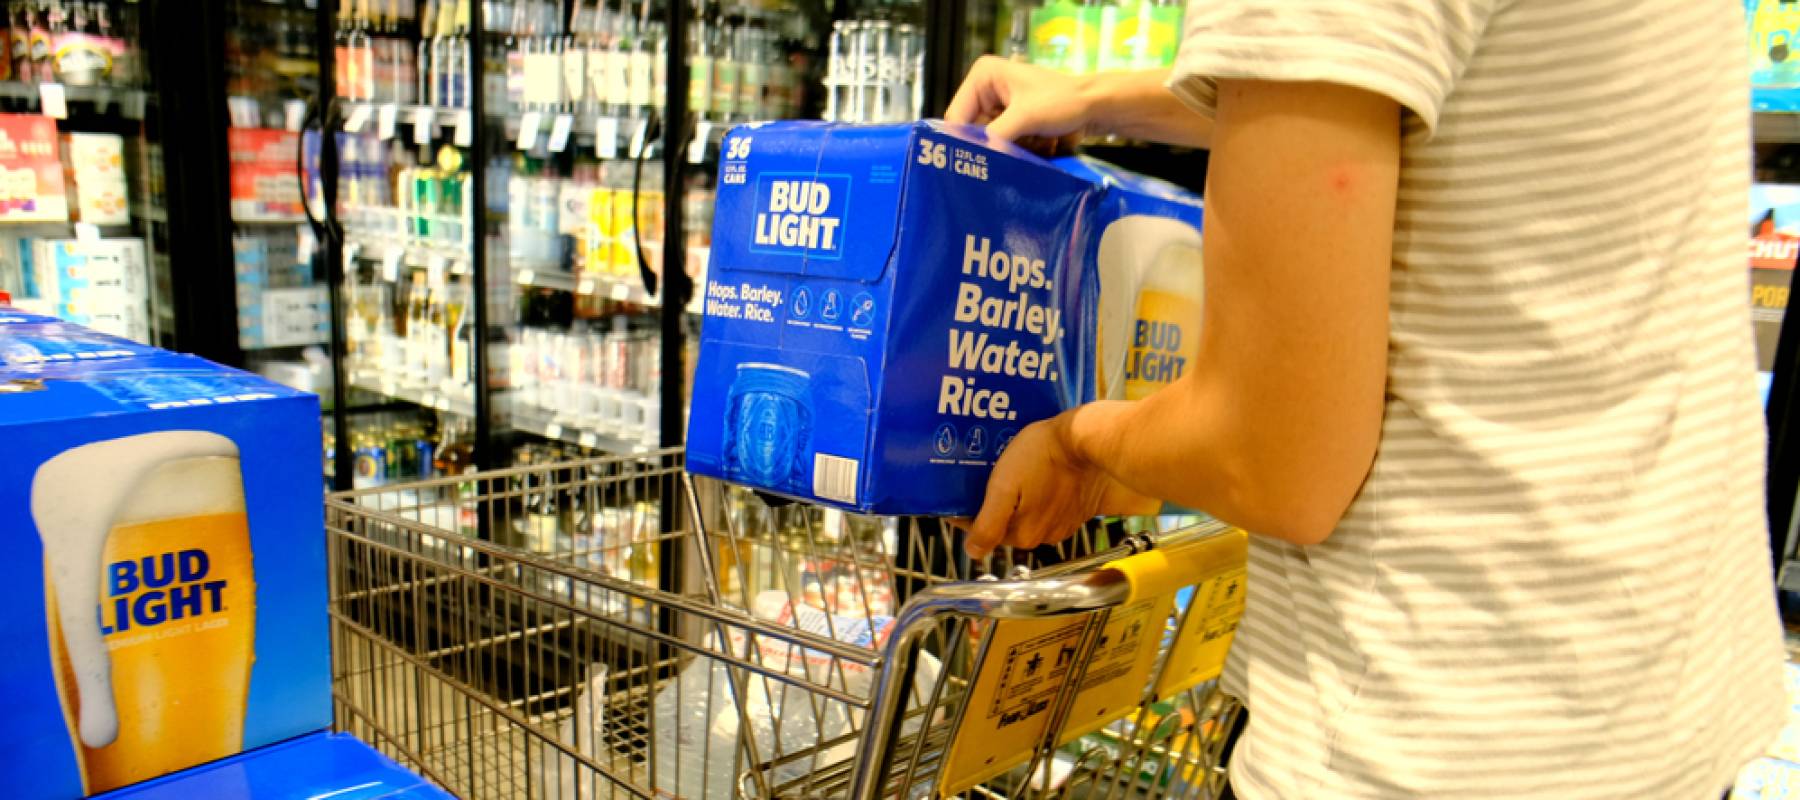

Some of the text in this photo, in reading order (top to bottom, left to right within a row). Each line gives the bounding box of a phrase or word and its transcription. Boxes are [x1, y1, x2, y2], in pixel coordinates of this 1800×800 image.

[726, 136, 752, 160] 36
[918, 138, 947, 169] 36
[724, 172, 747, 184] CANS
[954, 158, 989, 181] CANS
[769, 181, 830, 215] BUD
[755, 213, 840, 249] LIGHT
[962, 234, 1052, 292] Hops.
[708, 280, 783, 306] Hops. Barley.
[706, 300, 743, 319] Water.
[744, 303, 774, 323] Rice.
[954, 282, 1065, 344] Barley.
[1134, 318, 1182, 352] BUD
[948, 328, 1057, 381] Water.
[937, 375, 1017, 420] Rice.
[108, 548, 210, 596] BUD
[96, 580, 228, 635] LIGHT
